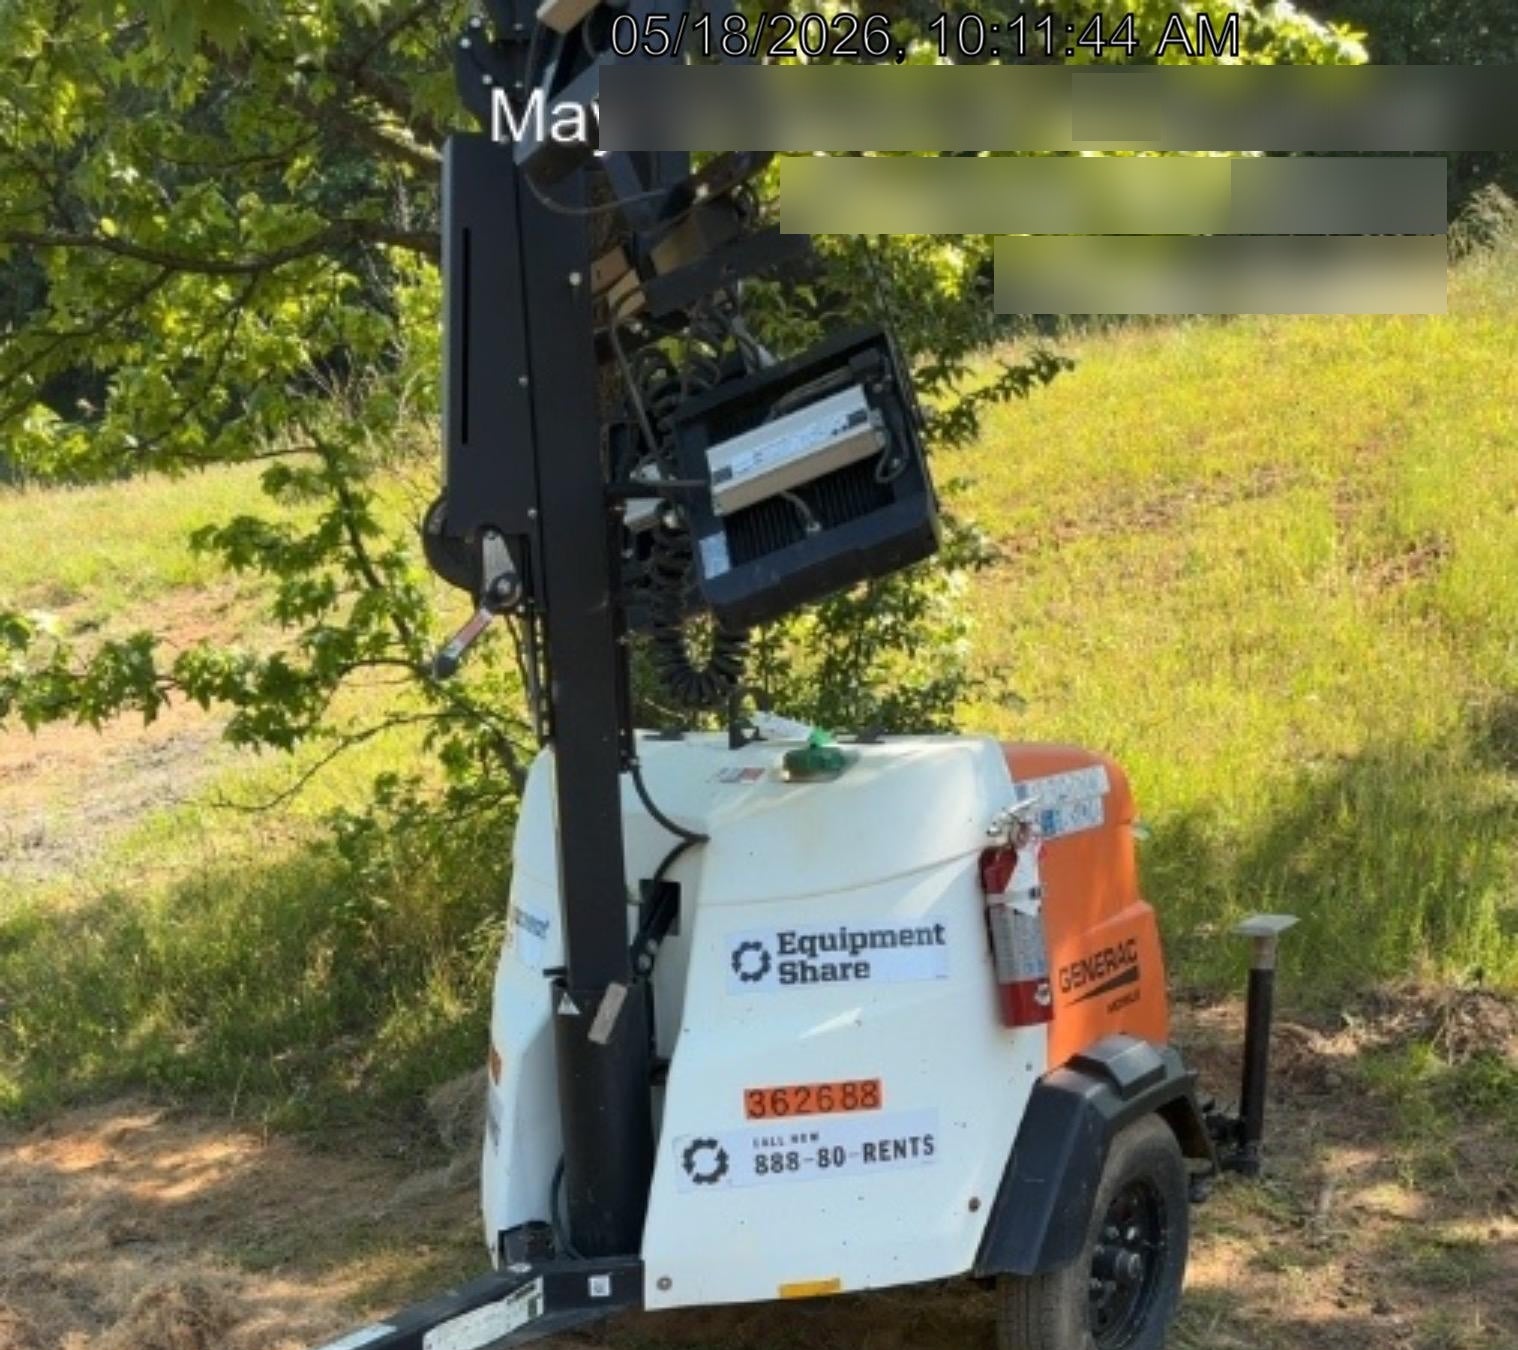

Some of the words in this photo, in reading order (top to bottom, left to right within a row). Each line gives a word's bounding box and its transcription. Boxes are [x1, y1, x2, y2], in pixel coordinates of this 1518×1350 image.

[777, 923, 947, 959] Equipment
[777, 959, 870, 985] Share
[1058, 938, 1138, 993] GENERAC
[747, 1080, 880, 1119] 362688
